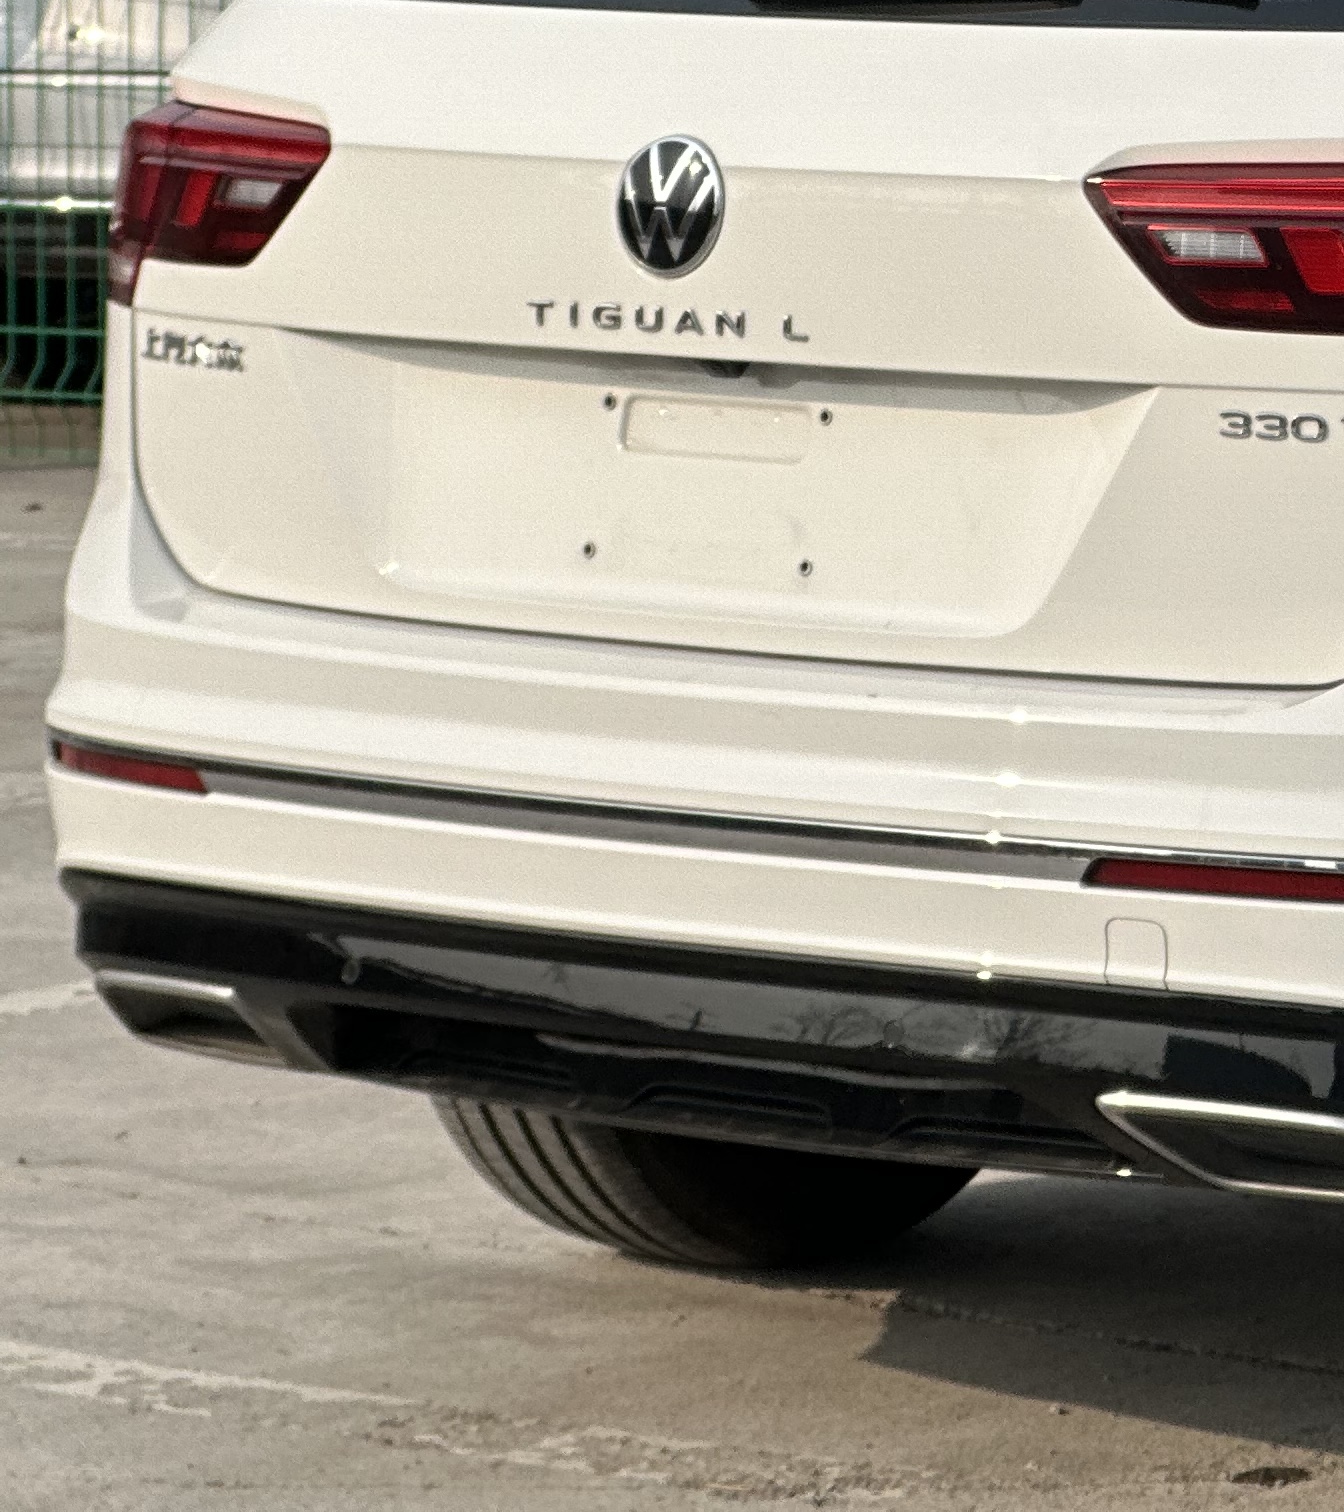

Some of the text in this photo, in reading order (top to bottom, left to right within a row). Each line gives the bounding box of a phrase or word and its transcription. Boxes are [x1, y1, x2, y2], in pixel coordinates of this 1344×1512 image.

[527, 299, 810, 344] TIGUAN L
[1219, 410, 1330, 444] 330
